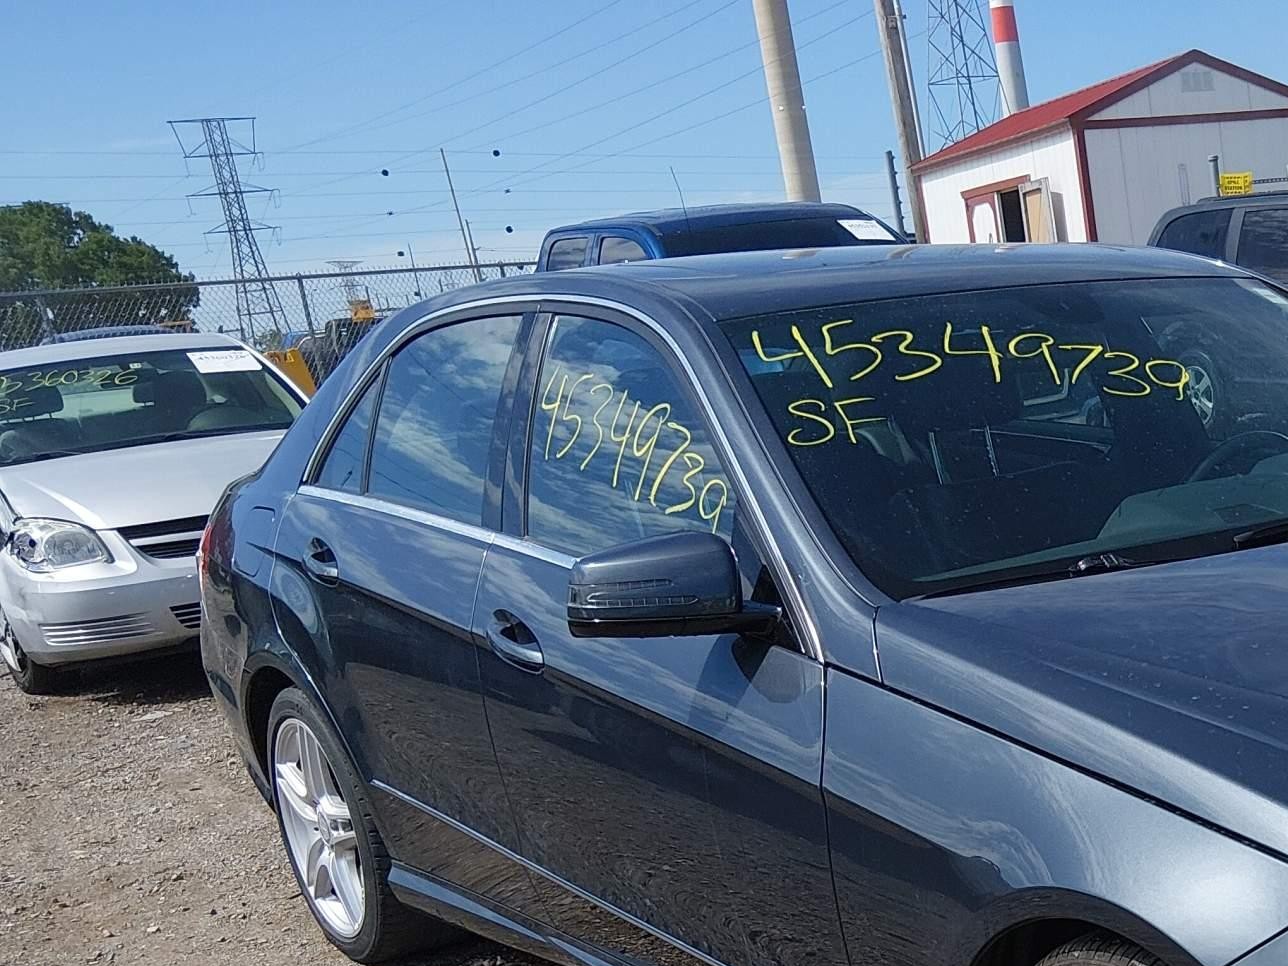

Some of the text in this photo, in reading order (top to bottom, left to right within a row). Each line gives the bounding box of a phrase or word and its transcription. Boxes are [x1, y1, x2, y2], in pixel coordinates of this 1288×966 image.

[0, 368, 138, 395] 5360326
[751, 319, 1190, 401] 45349739
[541, 366, 728, 534] 45349739
[787, 397, 888, 446] SF
